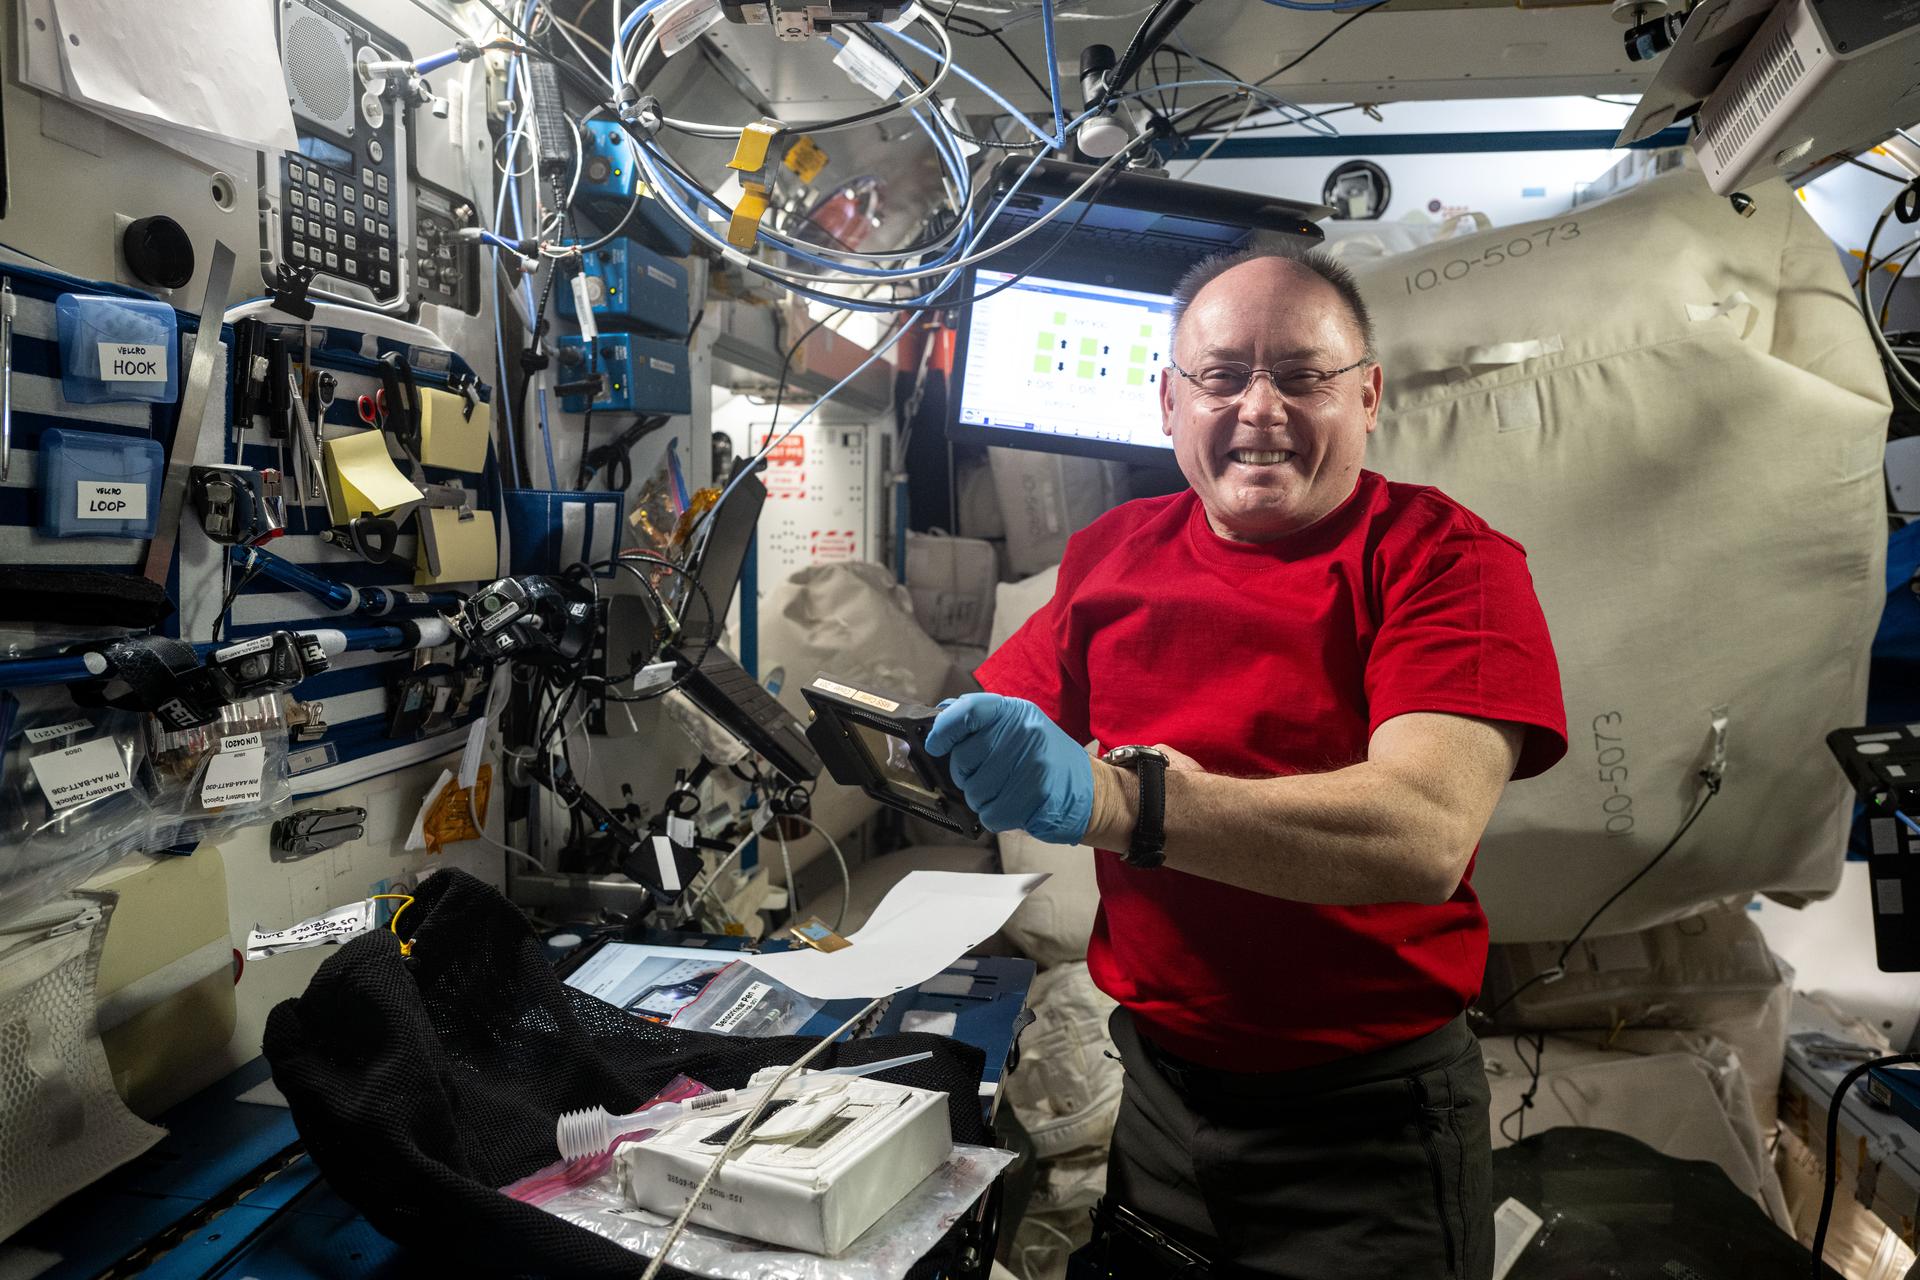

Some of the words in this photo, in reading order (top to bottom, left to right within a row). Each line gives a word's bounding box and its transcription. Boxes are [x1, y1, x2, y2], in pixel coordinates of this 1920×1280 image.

[117, 346, 146, 355] VELCRO
[113, 360, 156, 375] HOOK
[95, 487, 122, 495] VELCRO
[90, 500, 126, 512] LOOP
[225, 738, 246, 749] 0420)
[105, 770, 120, 781] P/N
[51, 775, 104, 795] AA-BATT-036
[114, 781, 126, 790] AA
[85, 785, 114, 797] Battery
[55, 793, 85, 806] Ziplock
[314, 921, 337, 931] EVA
[341, 917, 358, 926] US
